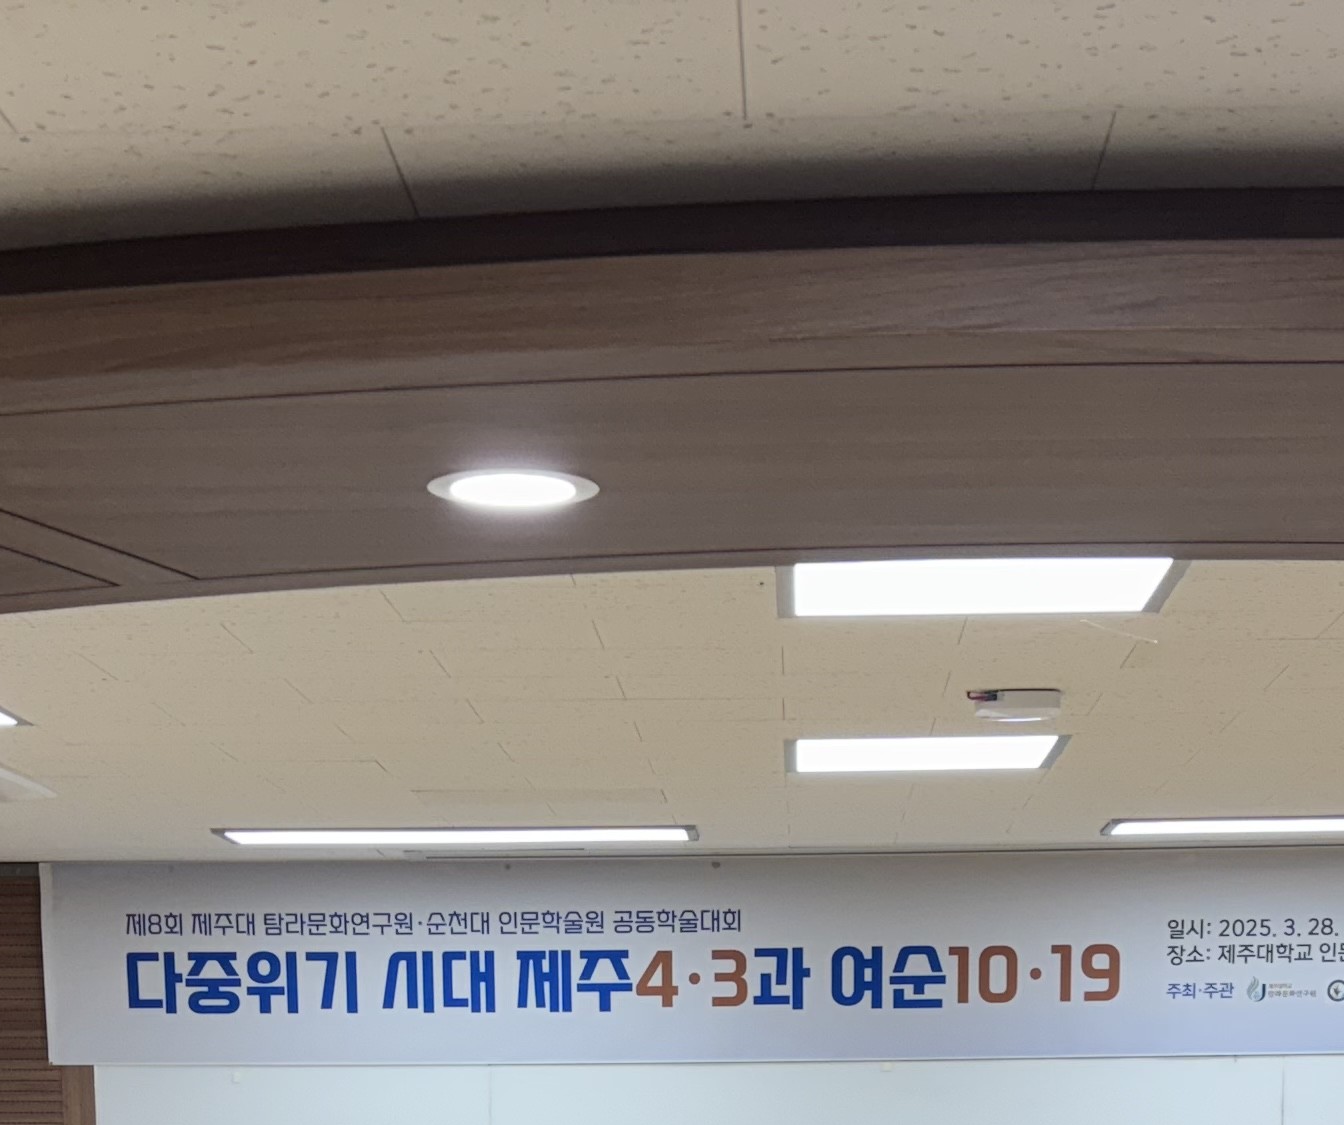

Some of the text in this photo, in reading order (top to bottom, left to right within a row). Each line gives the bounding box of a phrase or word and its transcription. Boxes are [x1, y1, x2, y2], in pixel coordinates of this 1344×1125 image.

[126, 912, 183, 936] 제8회
[191, 912, 256, 936] 제주대
[498, 909, 605, 935] 인문학술원
[612, 908, 742, 934] 공동학술대회
[1167, 918, 1212, 940] 일시:
[1218, 918, 1277, 938] 2025.
[1283, 917, 1301, 938] 3.
[1307, 917, 1339, 937] 28.
[1166, 944, 1211, 966] 장소:
[1218, 942, 1314, 965] 제주대학교
[126, 943, 1121, 1015] 다중위기 시대 제주4·3과 여순10·19
[1166, 981, 1235, 1000] 주최·주관
